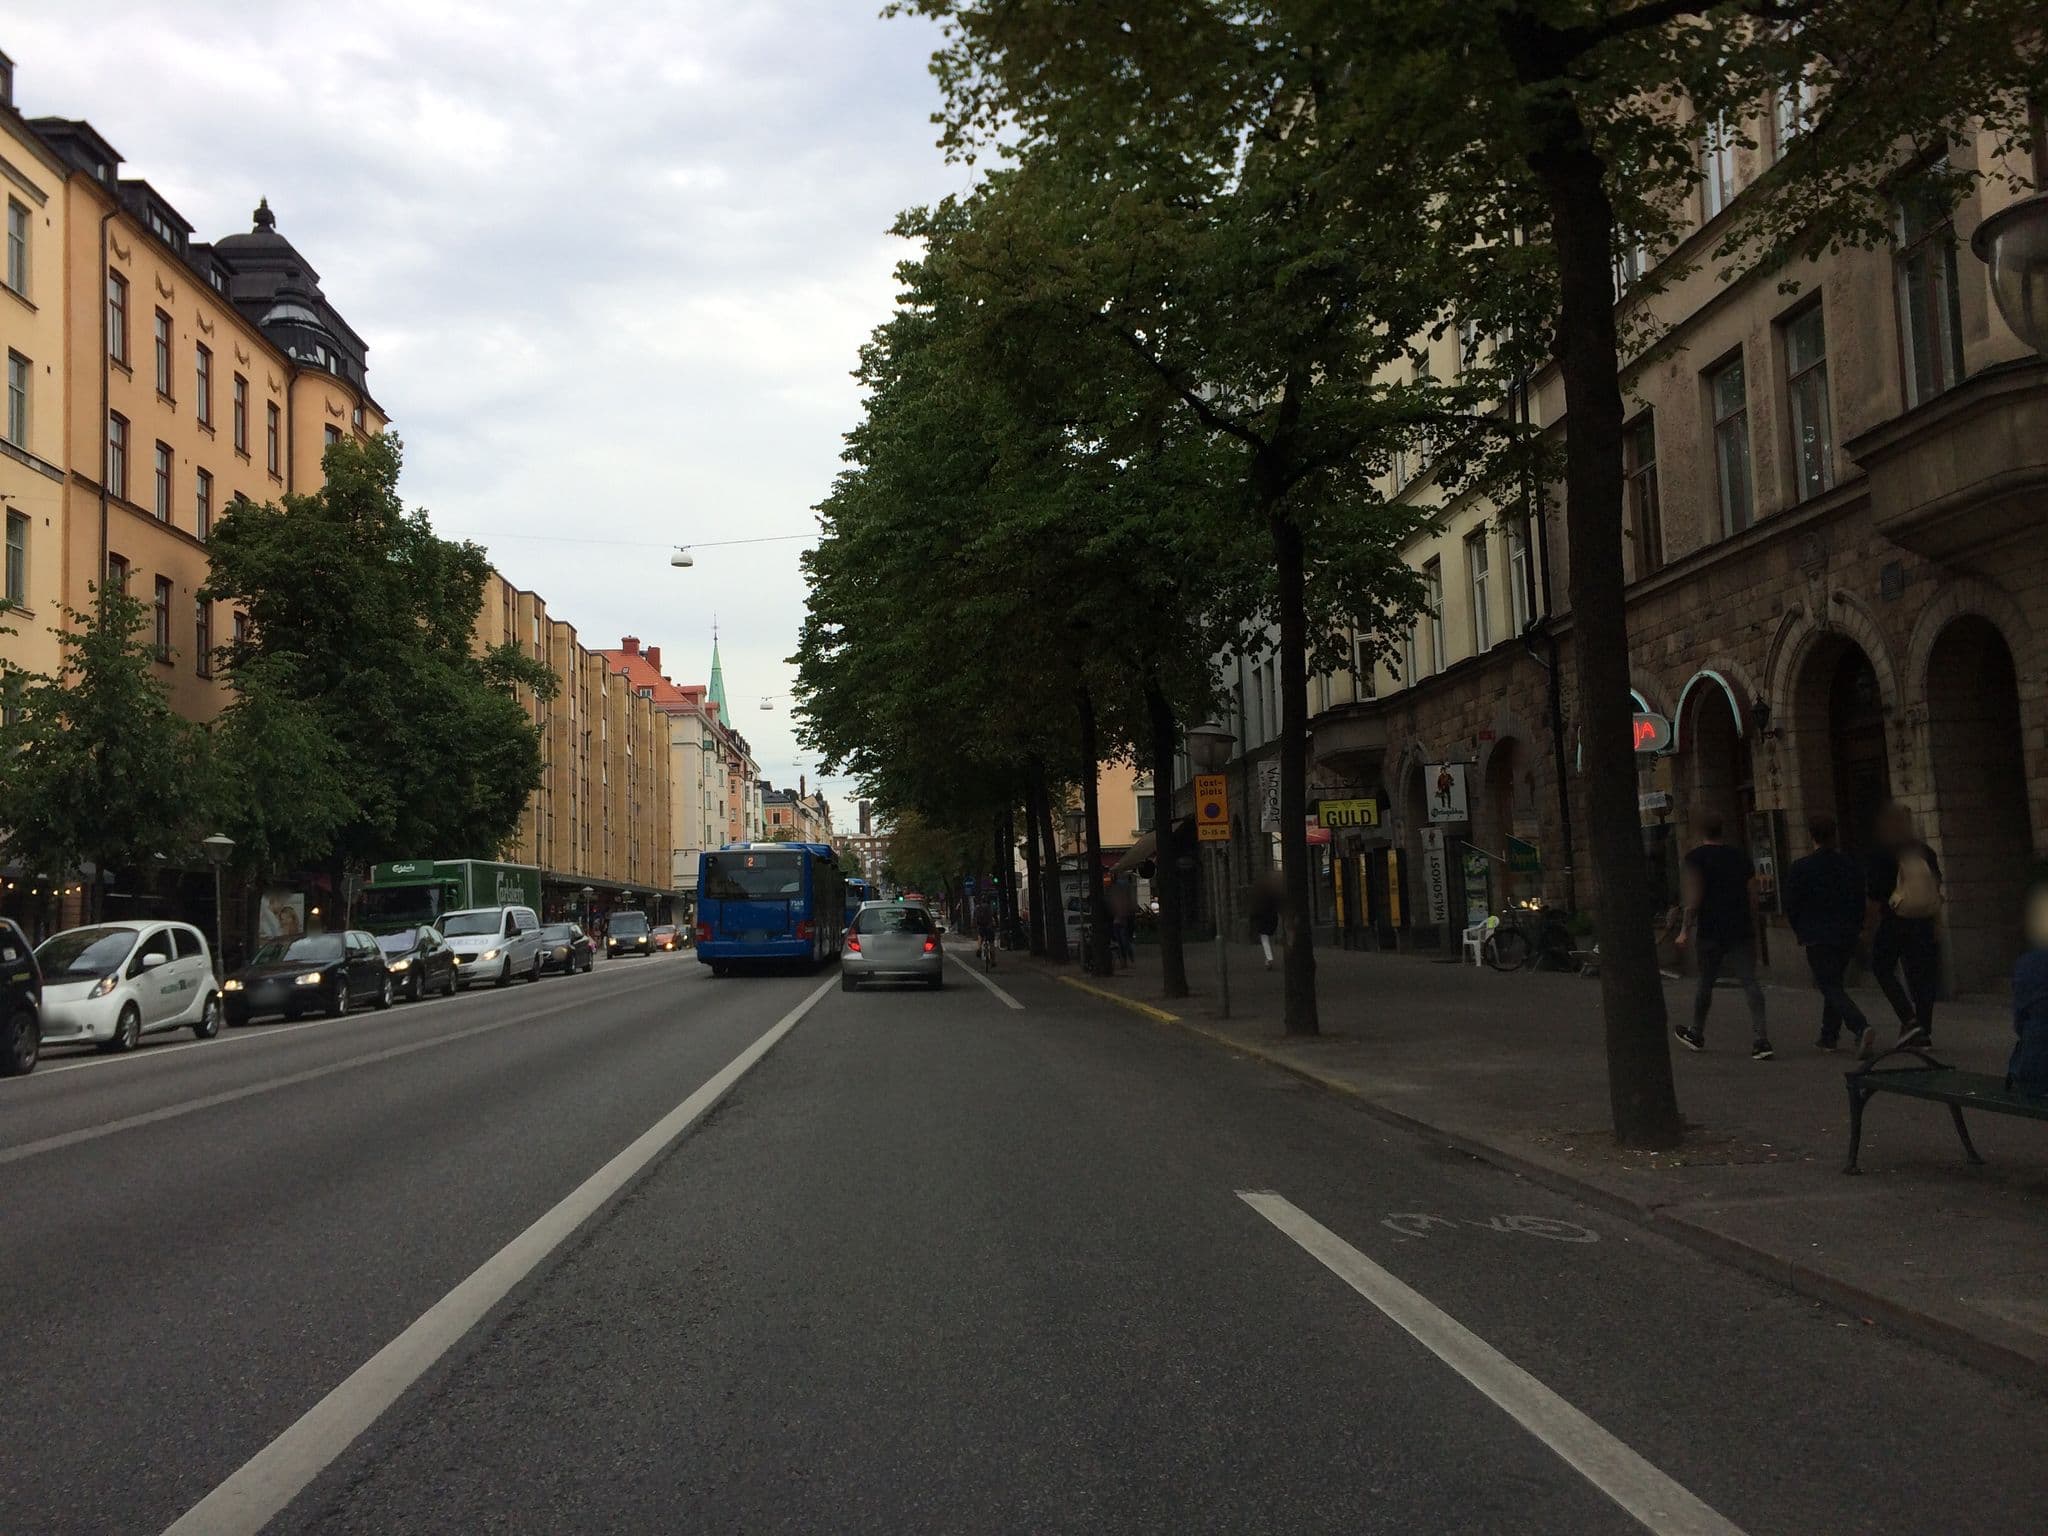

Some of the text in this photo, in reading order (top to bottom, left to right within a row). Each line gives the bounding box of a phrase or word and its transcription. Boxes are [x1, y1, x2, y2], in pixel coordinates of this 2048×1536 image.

[1267, 767, 1281, 825] Vincent
[1326, 809, 1372, 826] GULD
[392, 863, 416, 874] Carlsberg
[747, 856, 754, 868] 2
